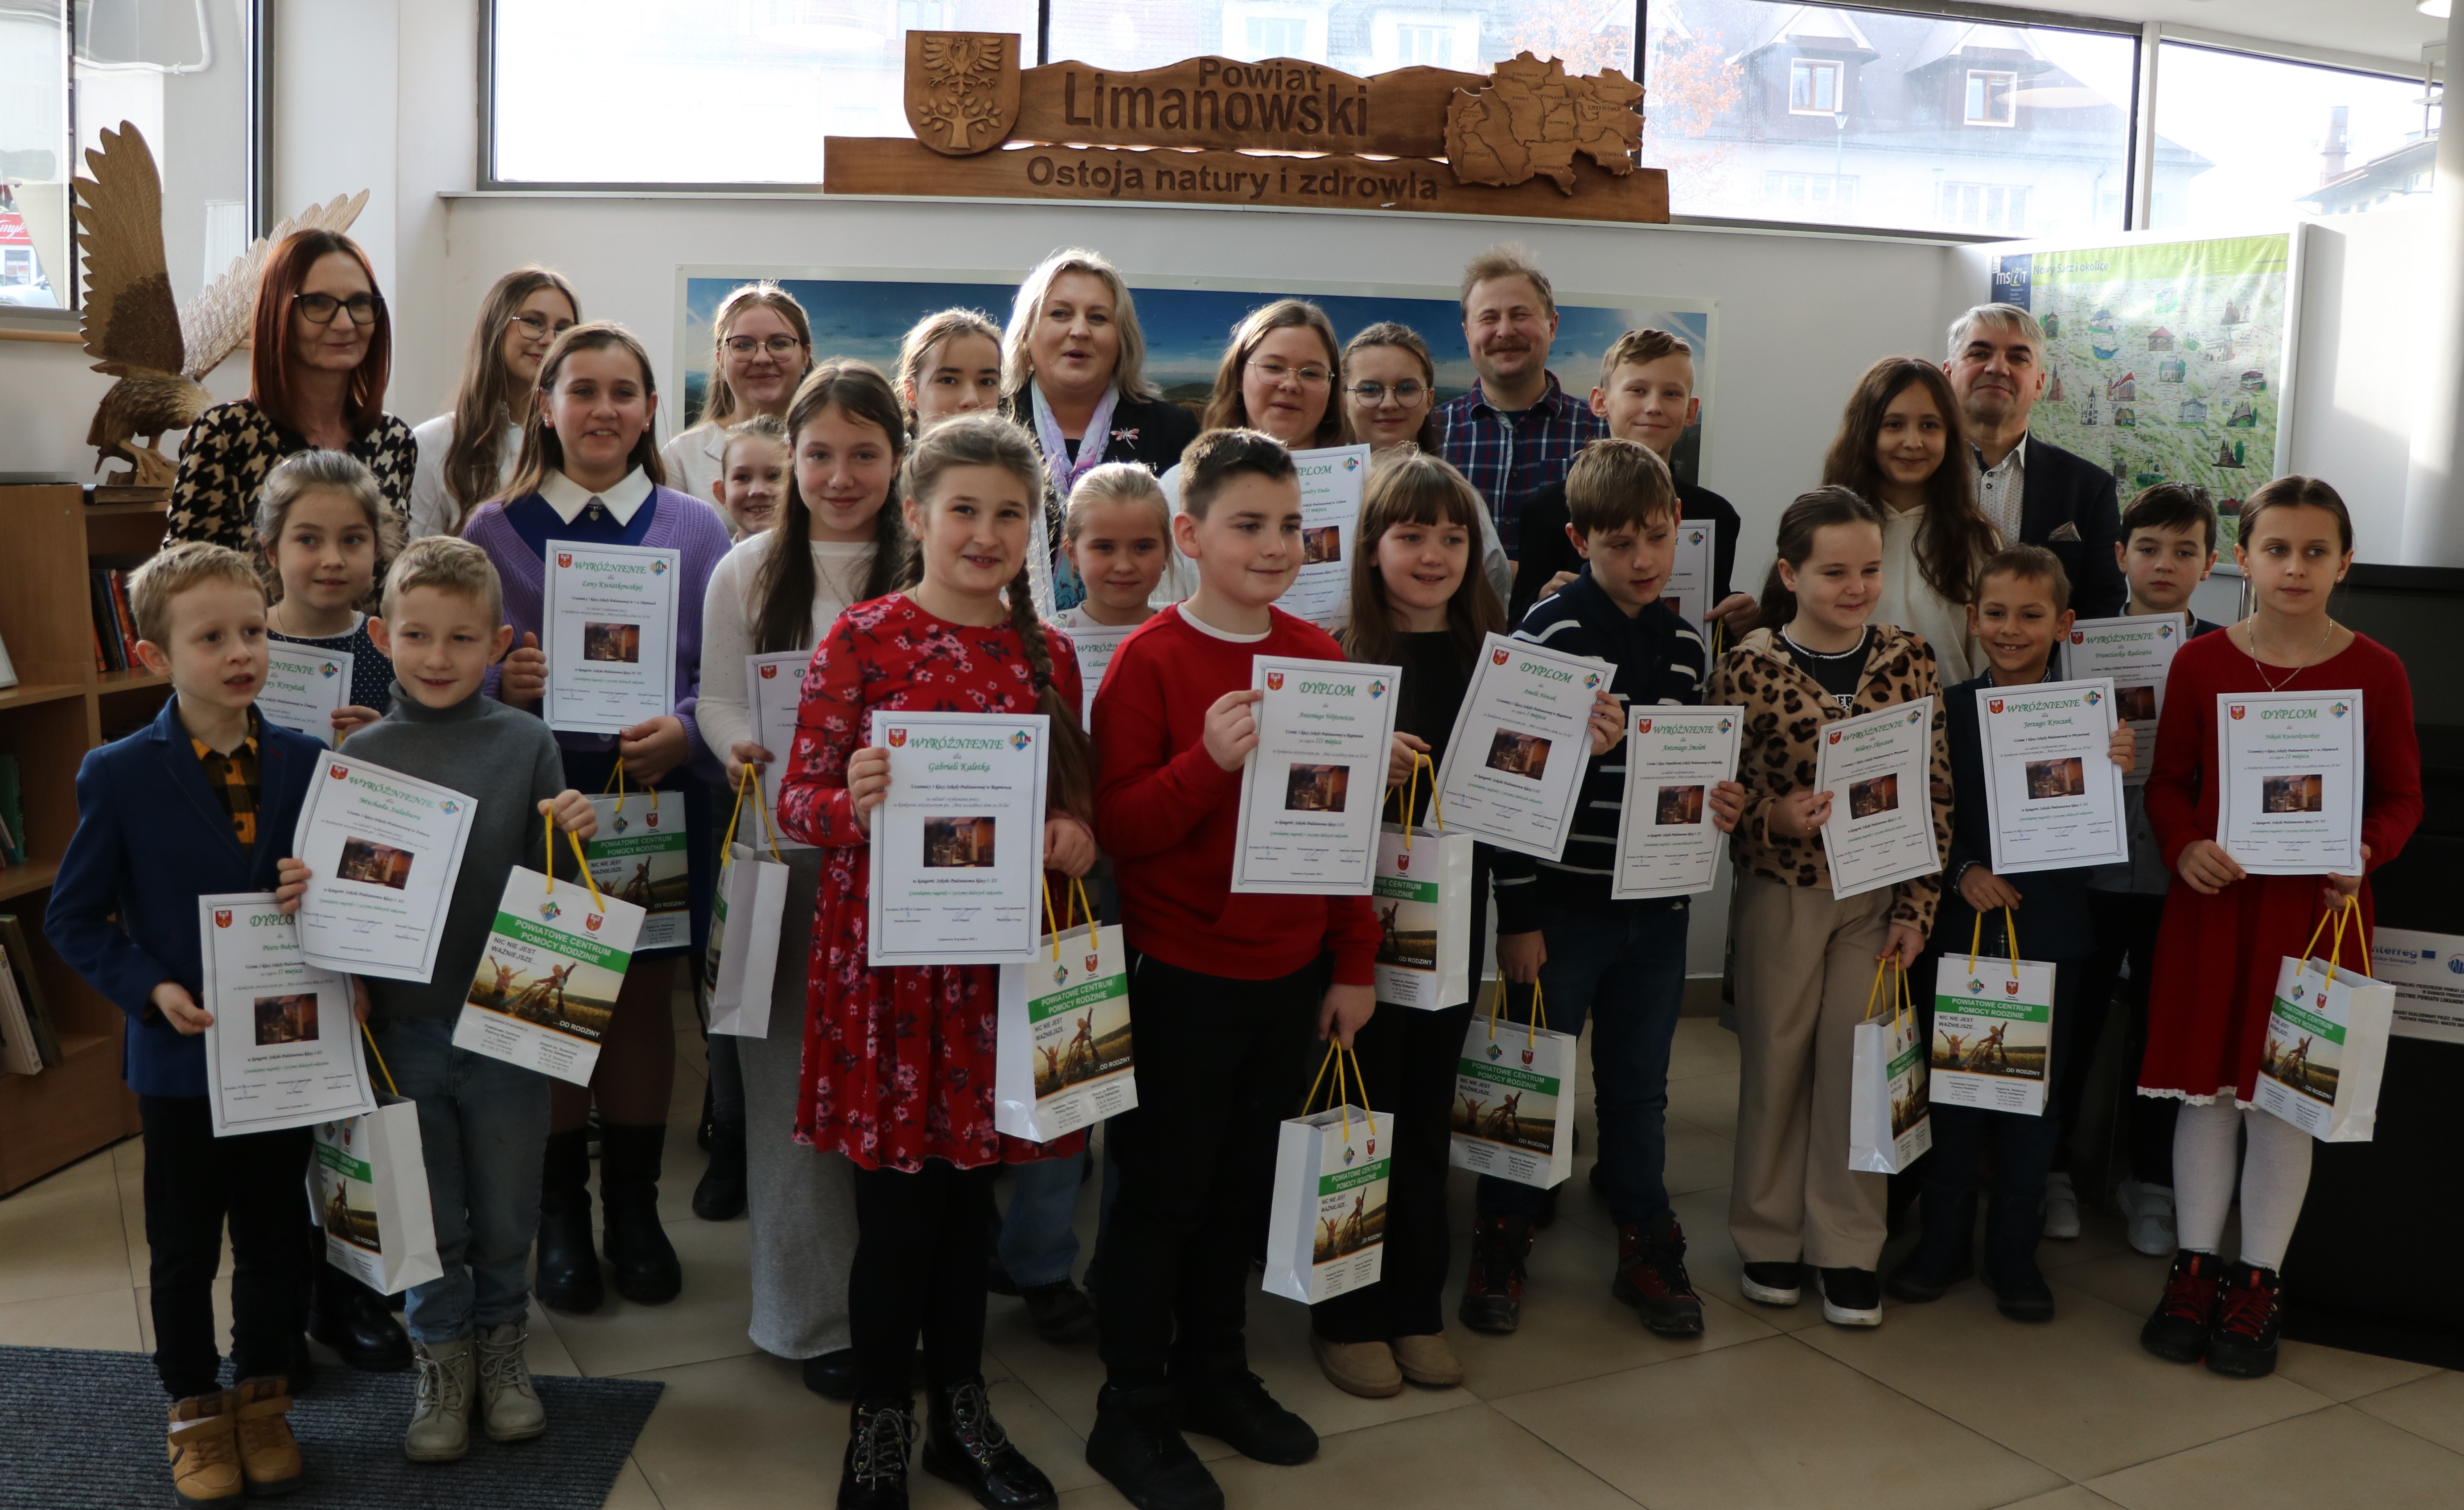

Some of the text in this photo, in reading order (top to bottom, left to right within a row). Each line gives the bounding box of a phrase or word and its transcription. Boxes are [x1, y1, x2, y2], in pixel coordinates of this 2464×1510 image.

[1199, 58, 1321, 90] Powiat
[1065, 72, 1367, 136] Limanowski
[1028, 156, 1438, 200] Ostoja natury i zdrowia
[2033, 265, 2055, 276] Nowy
[2076, 263, 2077, 272] i
[2080, 261, 2108, 272] okolice
[574, 560, 646, 574] WYRÓŻNIENIE
[599, 582, 643, 592] Kwiatkowskiej
[2086, 632, 2154, 645] WYRÓŻNIENIE
[269, 659, 315, 675] ŻNIENIE
[1520, 662, 1574, 683] DYPLOM
[277, 682, 307, 693] Krzyżak
[1300, 682, 1356, 696] DYPLOM
[1539, 692, 1557, 702] Nowak
[2006, 699, 2080, 713] WYRÓŻNIENIE
[1298, 712, 1325, 720] Antoniego
[1530, 712, 1546, 720] miejsca
[2261, 709, 2317, 720] DYPLOM
[1654, 724, 1714, 735] WYRÓŻNIENIE
[2023, 717, 2073, 728] Jerzego Kroczek
[1842, 720, 1904, 742] WYRÓŻNIENIE
[909, 737, 1004, 750] WYRÓŻNIENIE
[1872, 738, 1894, 749] Skoczeń
[928, 762, 991, 772] Gabrieli Kaletka
[349, 777, 434, 809] WYRÓŻNIENIE
[359, 797, 421, 820] Michała Salabura
[601, 835, 672, 848] POWIATOWE CENTRUM
[608, 848, 634, 856] POMOCY
[1389, 880, 1421, 890] CENTRUM
[1383, 889, 1414, 898] RODZINIE
[250, 913, 296, 928] DYPLO
[515, 920, 611, 957] POWIATOWE CENTRUM
[494, 937, 536, 955] NIC NIE JEST
[521, 932, 600, 963] POMOCY RODZINIE
[2372, 945, 2417, 959] nterreg
[2372, 956, 2417, 965] olska-Słowacja
[1041, 979, 1113, 1007] POWIATOWE CENTRUM
[1049, 991, 1107, 1014] POMOCY RODZINIE
[1952, 998, 2032, 1011] POWIATOWE CENTRUM
[1959, 1007, 2024, 1018] POMOCY RODZINIE
[2280, 1001, 2333, 1030] POWIATOWE CENTRUM
[574, 1024, 600, 1038] RODZINY
[1035, 1024, 1043, 1032] NIC
[1051, 1017, 1062, 1026] JEST
[2281, 1012, 2325, 1036] POMOCY RODZINIE
[1109, 1056, 1130, 1067] RODZINY
[1472, 1062, 1545, 1083] POWIATOWE CENTRUM
[1478, 1072, 1537, 1090] POMOCY RODZINIE
[2312, 1088, 2332, 1100] RODZINY
[1527, 1140, 1550, 1149] RODZINY
[1332, 1162, 1382, 1182] POWIATOWE CENTRUM
[1337, 1172, 1376, 1190] POMOCY RODZINIE
[1367, 1233, 1382, 1242] RODZINY
